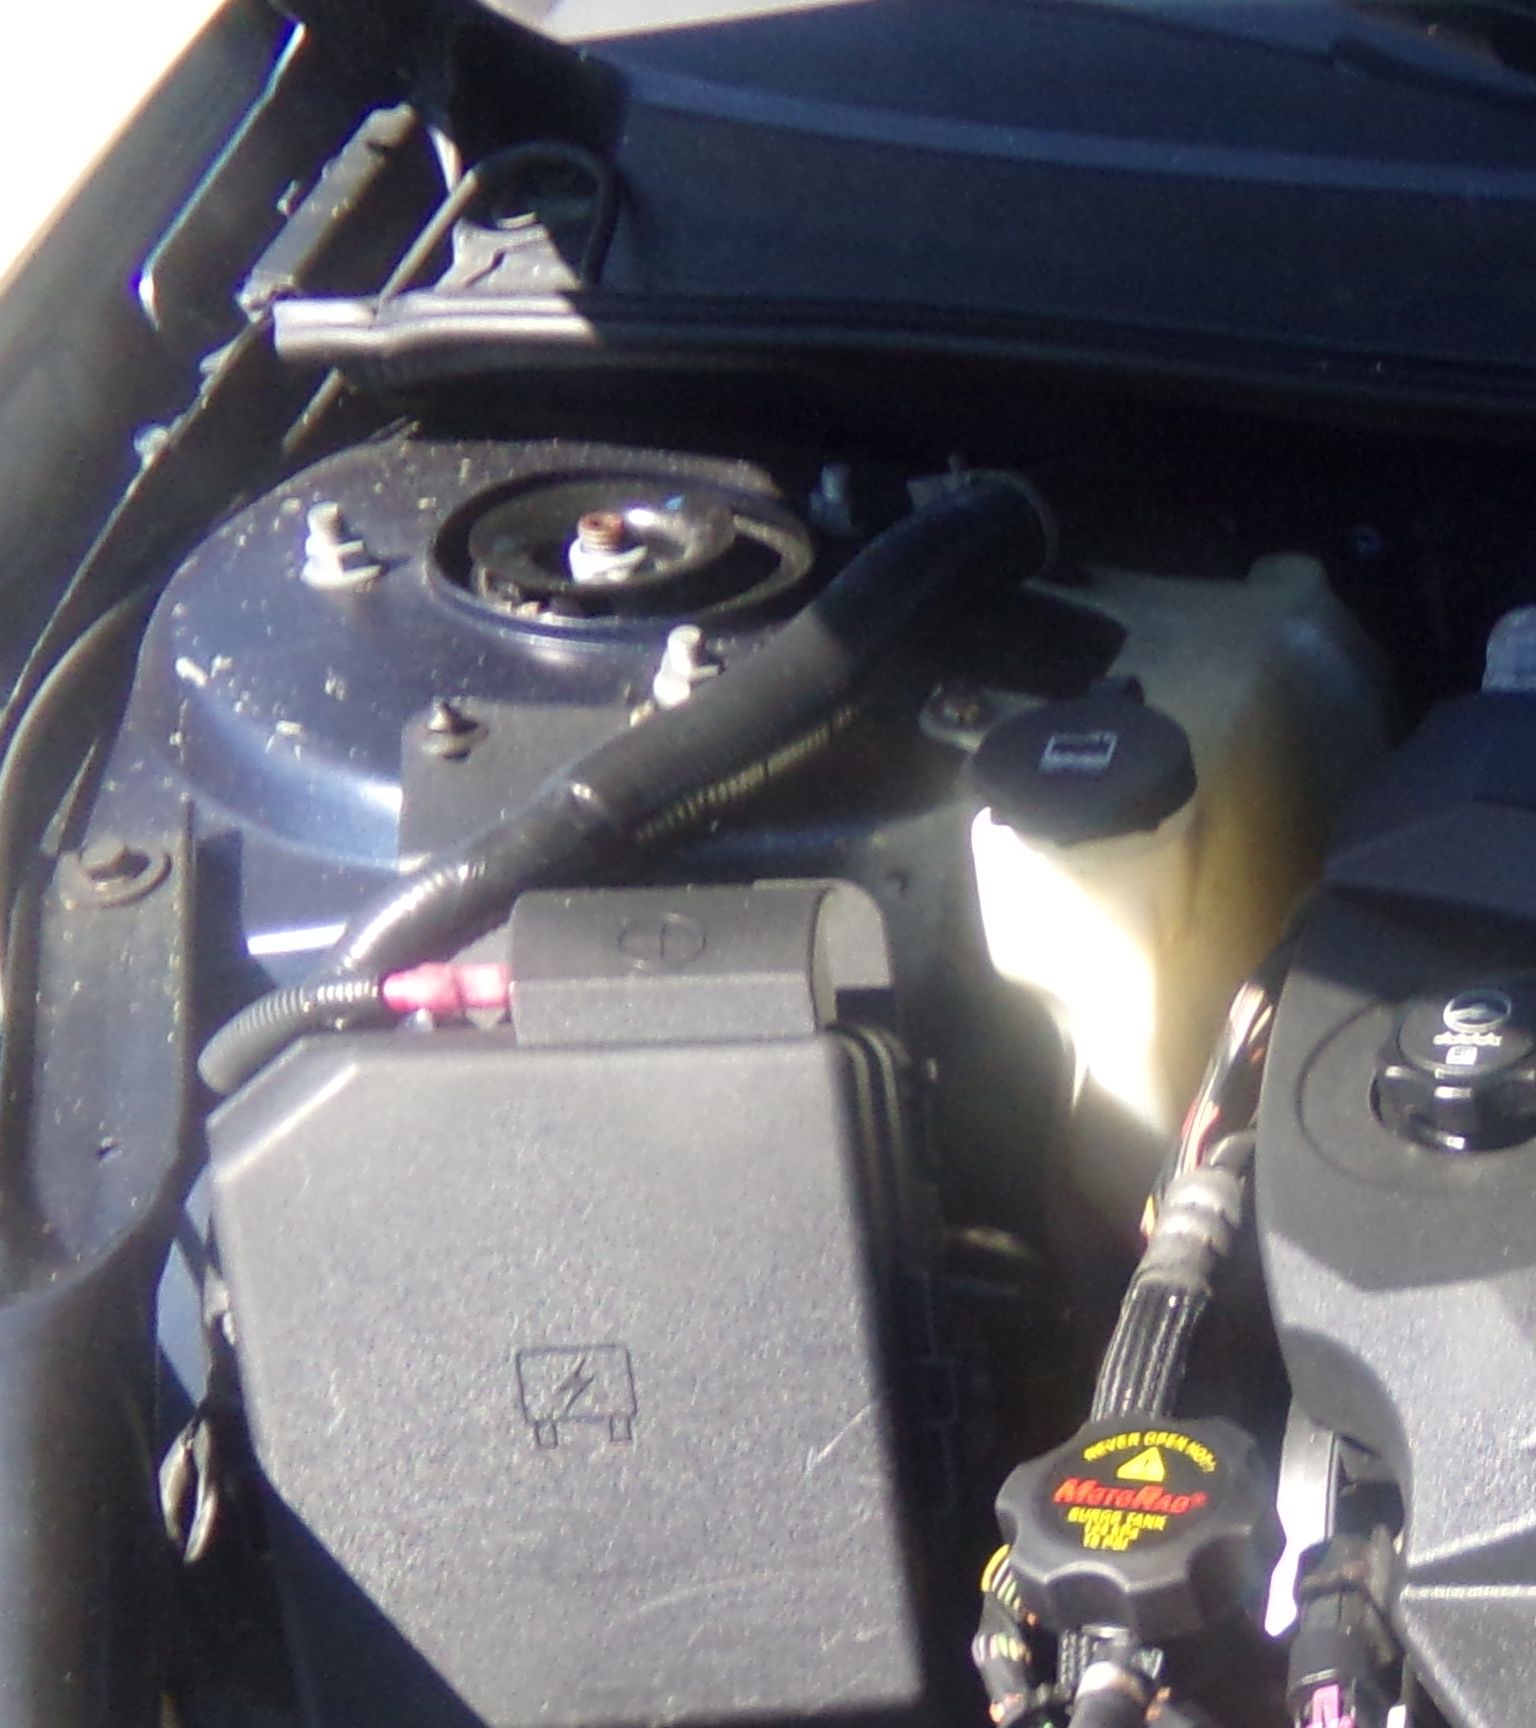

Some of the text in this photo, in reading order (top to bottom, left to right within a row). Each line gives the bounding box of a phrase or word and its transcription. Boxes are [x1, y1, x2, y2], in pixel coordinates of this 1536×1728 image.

[1083, 1431, 1140, 1461] NEVER
[1143, 1431, 1186, 1452] OPEN
[1126, 1512, 1168, 1531] TANK
